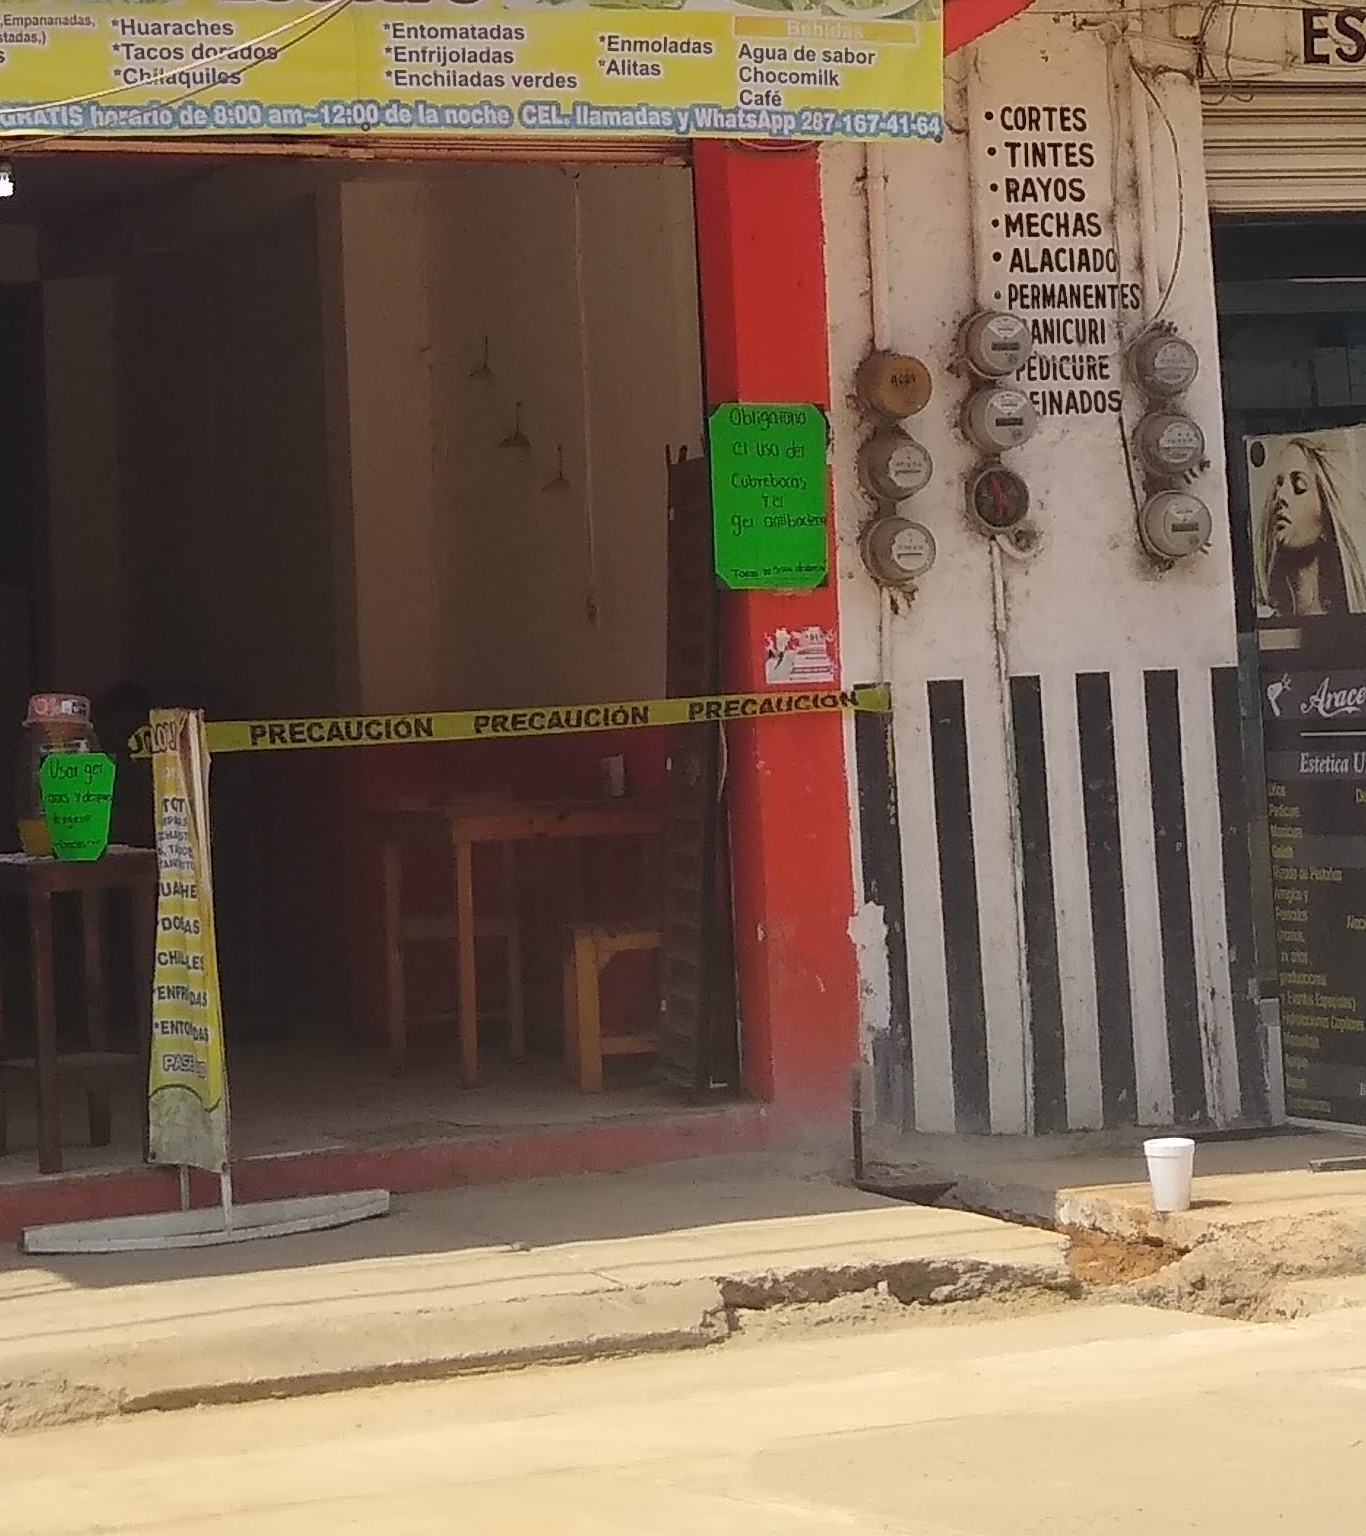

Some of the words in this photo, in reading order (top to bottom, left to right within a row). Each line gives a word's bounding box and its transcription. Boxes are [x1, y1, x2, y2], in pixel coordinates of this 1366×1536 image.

[738, 43, 787, 64] Agua
[793, 45, 816, 62] de
[822, 47, 876, 66] sabor
[512, 70, 578, 90] verdes
[739, 66, 840, 87] Chocomilk
[739, 89, 783, 107] Café
[89, 103, 173, 126] horario
[179, 104, 208, 126] de
[213, 104, 263, 126] 8:00
[383, 104, 415, 126] de
[417, 104, 441, 126] la
[444, 104, 511, 127] noche
[520, 105, 571, 128] CEL.
[574, 105, 673, 129] llamadas
[675, 110, 690, 134] y
[693, 107, 796, 135] WhatsApp
[1000, 106, 1087, 132] CORTES
[1005, 141, 1095, 168] TINTES
[1005, 177, 1086, 203] RAYOS
[1004, 212, 1102, 238] MECHAS
[1009, 247, 1118, 273] ALACIADO
[1008, 283, 1141, 310] PERMANENTES
[1029, 318, 1106, 346] ANICURI
[249, 715, 434, 746] PRECAUCIÓN
[472, 705, 650, 736] PRECAUCIÓN
[1299, 751, 1349, 774] Estetica
